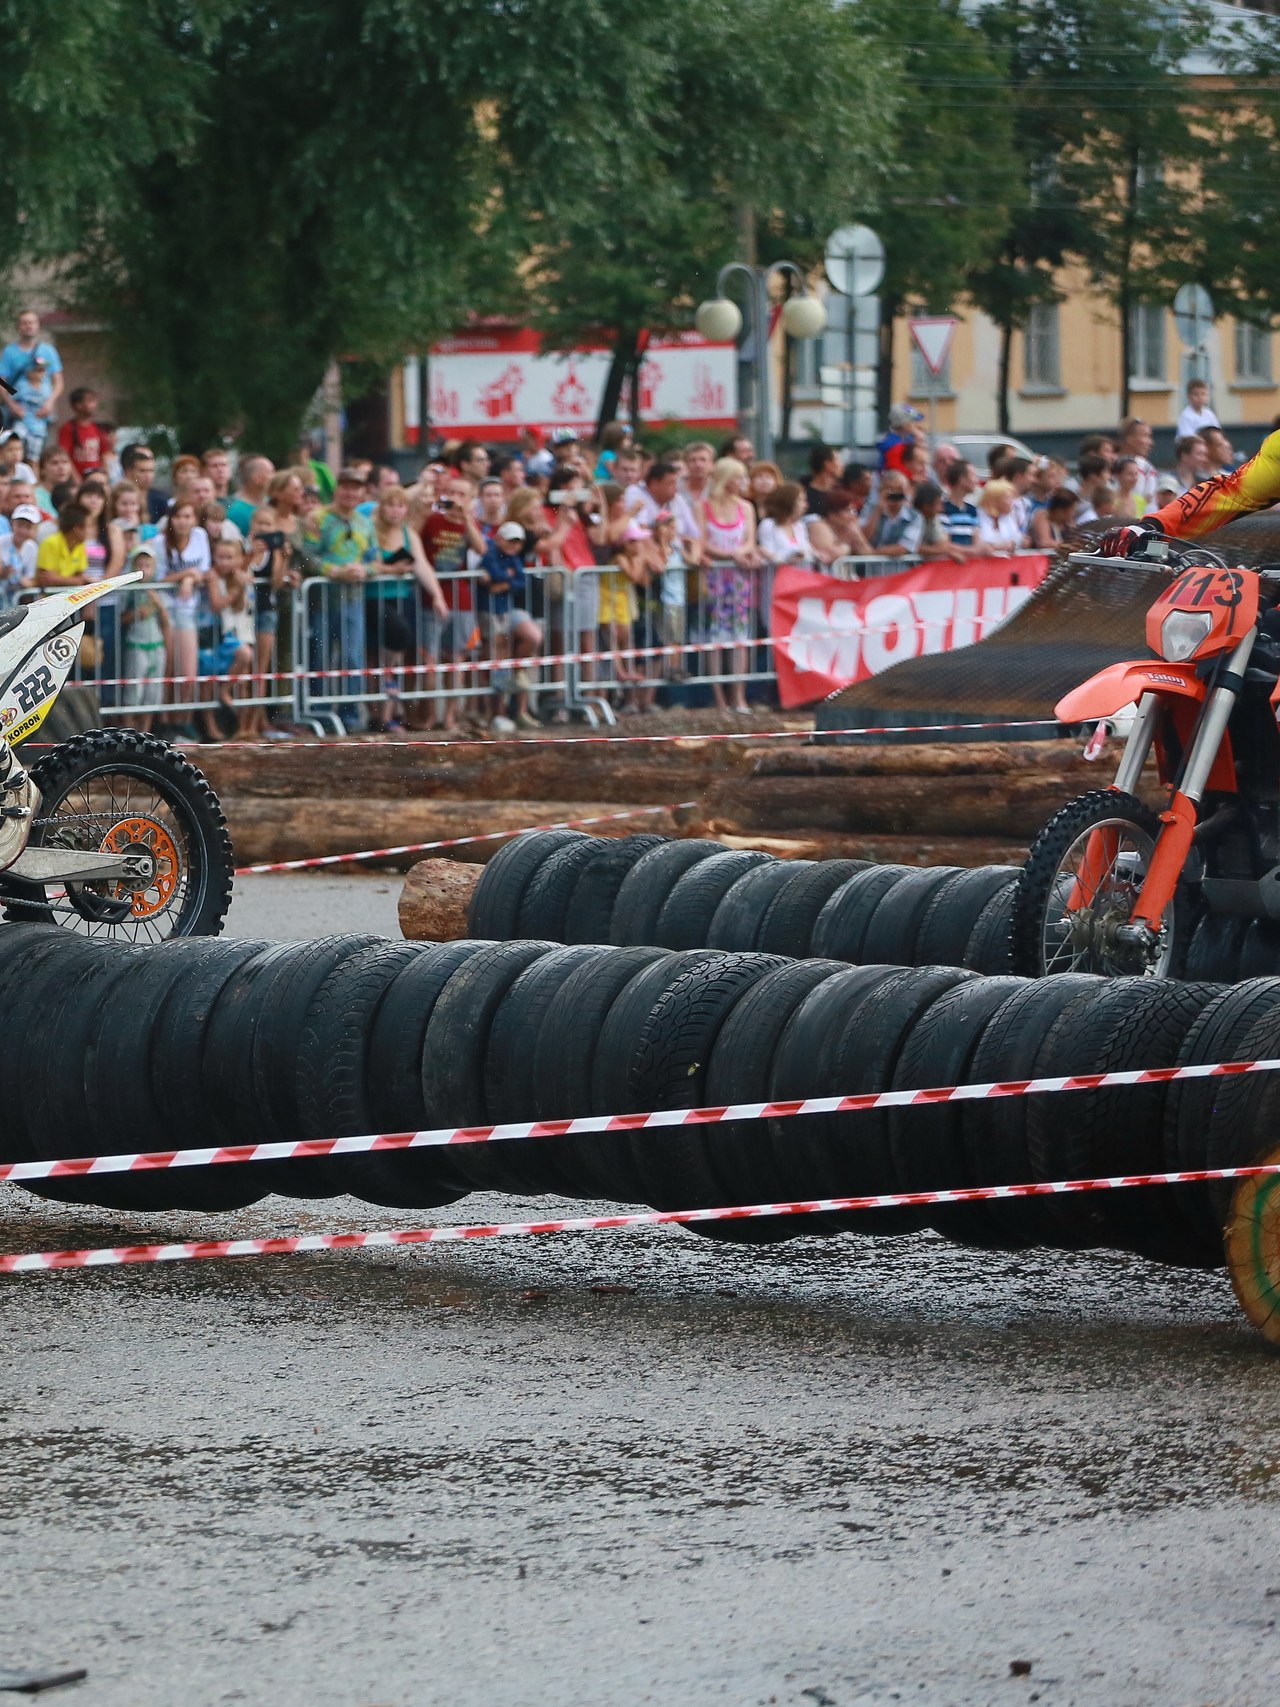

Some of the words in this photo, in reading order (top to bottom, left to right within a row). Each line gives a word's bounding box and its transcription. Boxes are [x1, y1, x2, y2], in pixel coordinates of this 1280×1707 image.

[68, 583, 111, 604] PIRELLI
[1169, 571, 1244, 607] 113
[11, 665, 58, 714] 222
[6, 713, 41, 743] KOPRON
